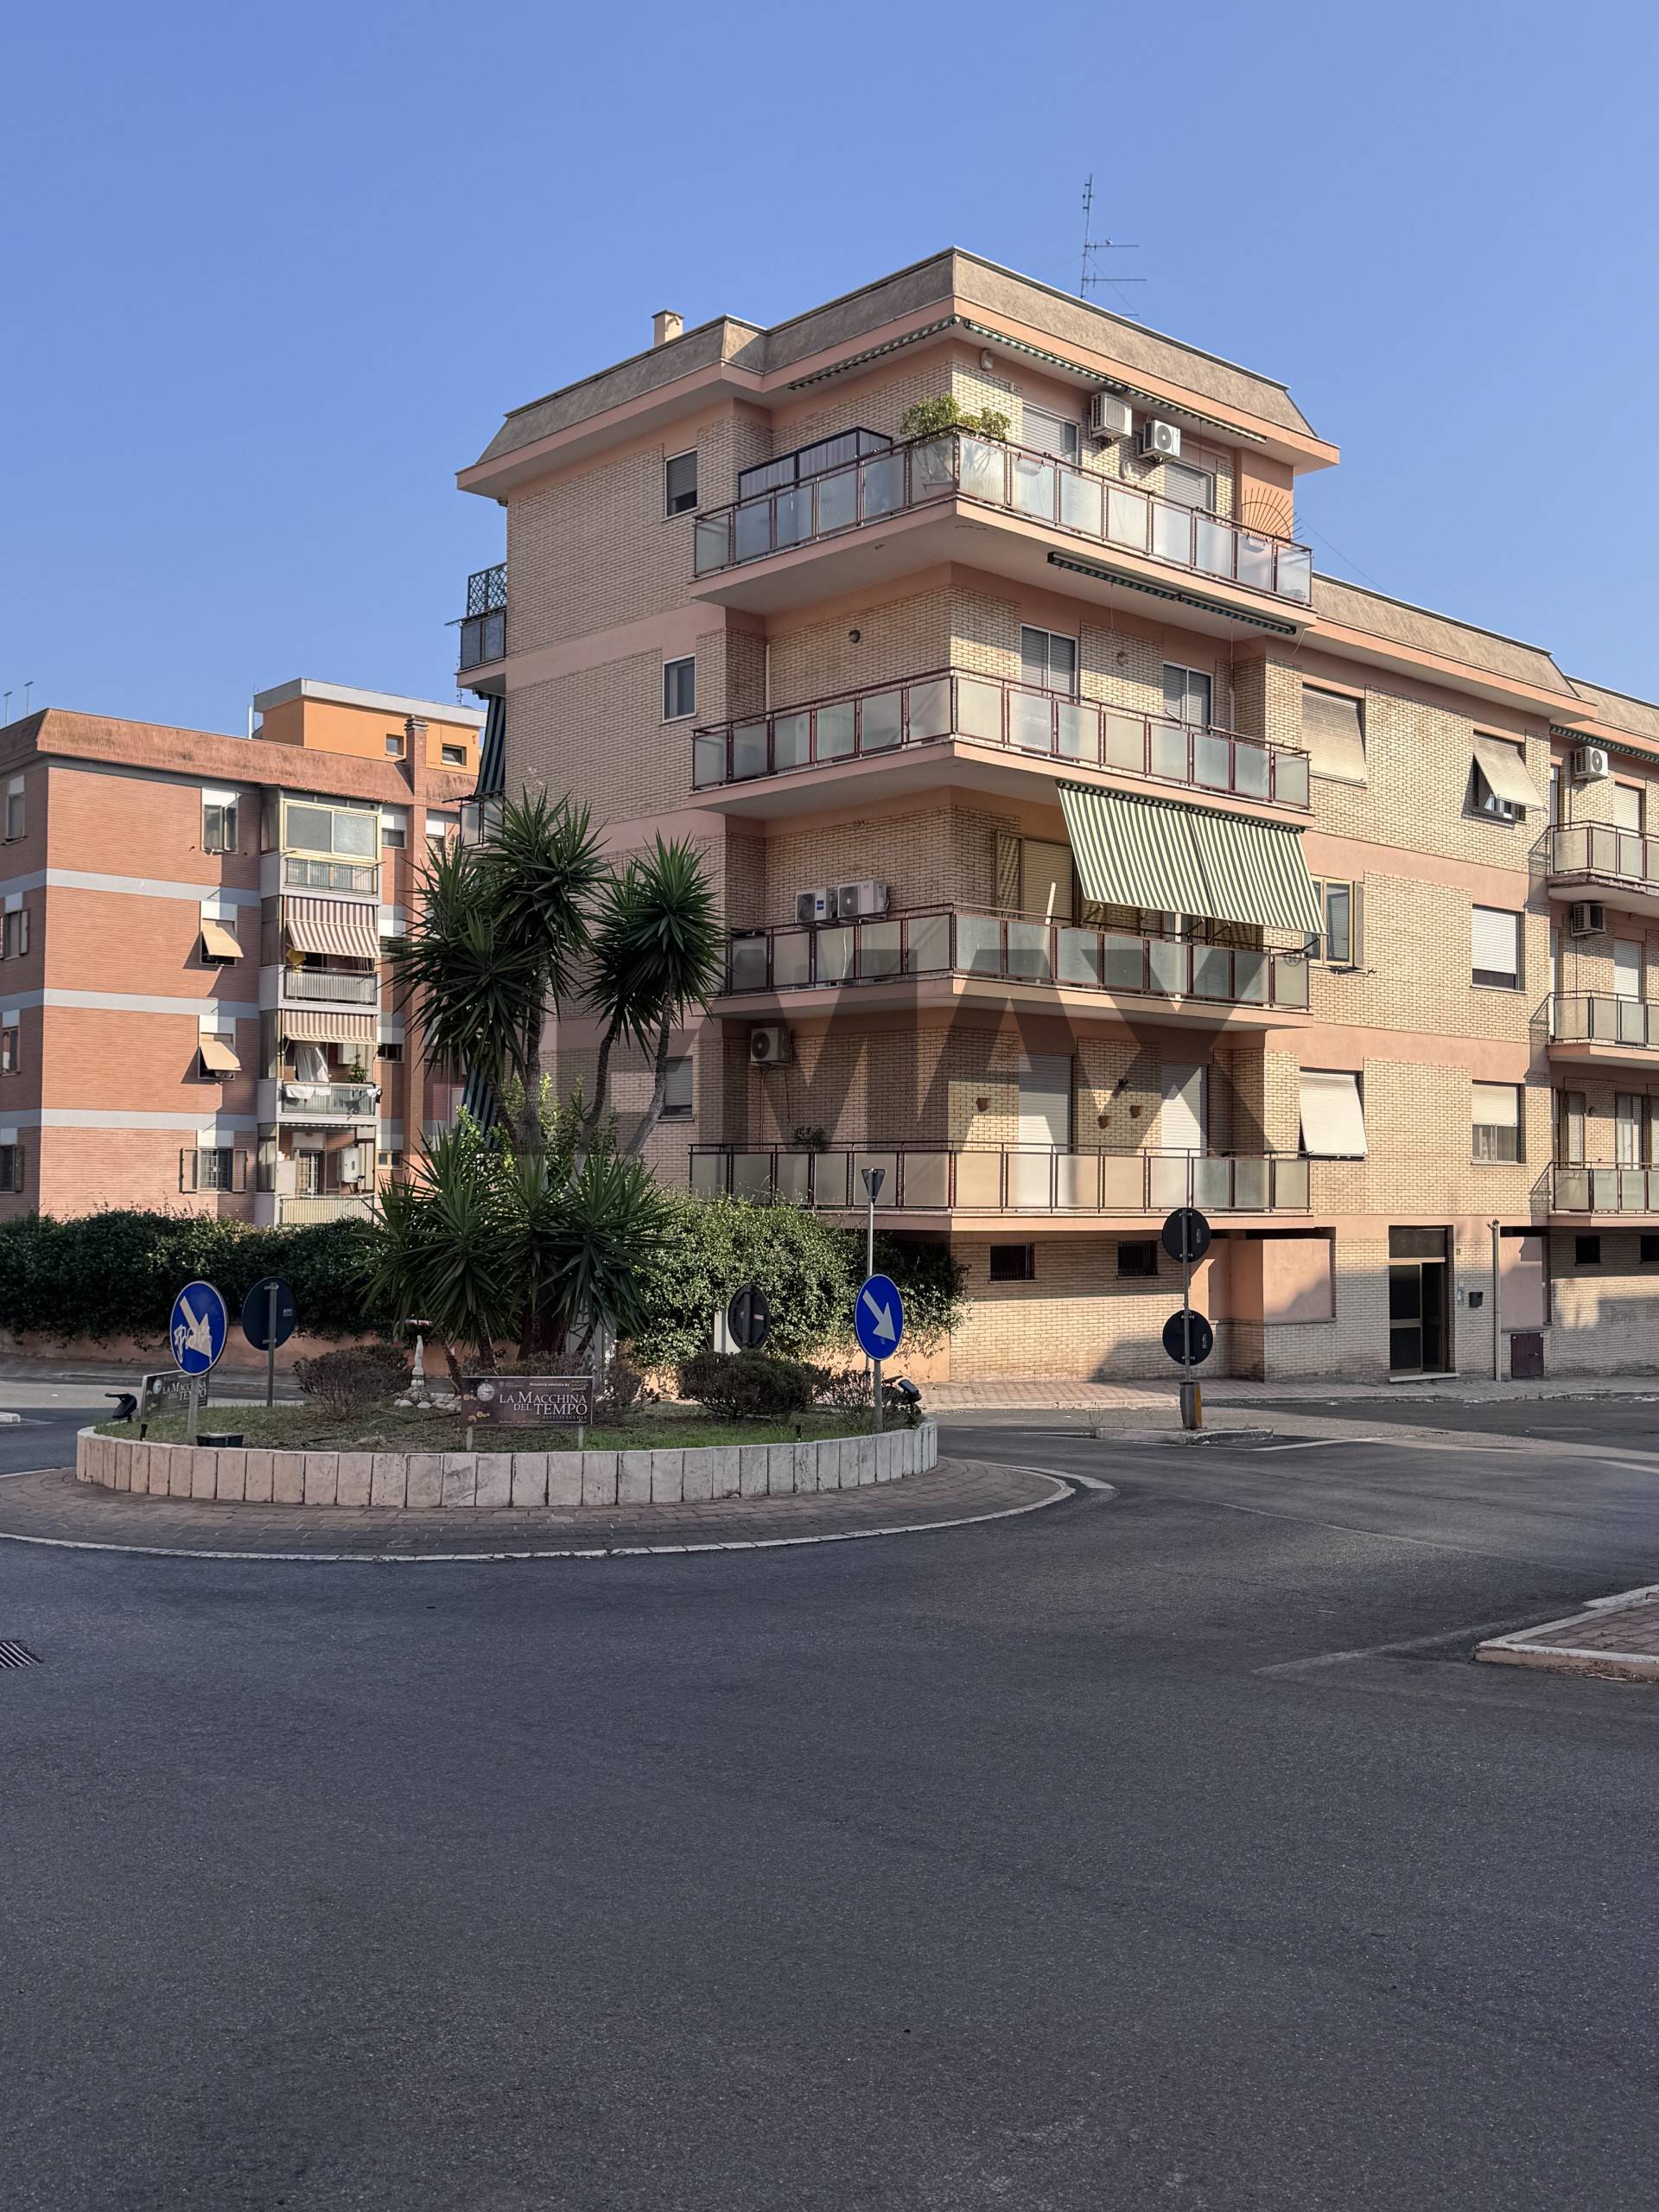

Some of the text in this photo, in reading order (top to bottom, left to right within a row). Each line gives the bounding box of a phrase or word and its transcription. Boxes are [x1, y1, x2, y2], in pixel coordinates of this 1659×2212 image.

[499, 1391, 587, 1403] LA MACCHINA
[533, 1403, 588, 1415] TEMPO
